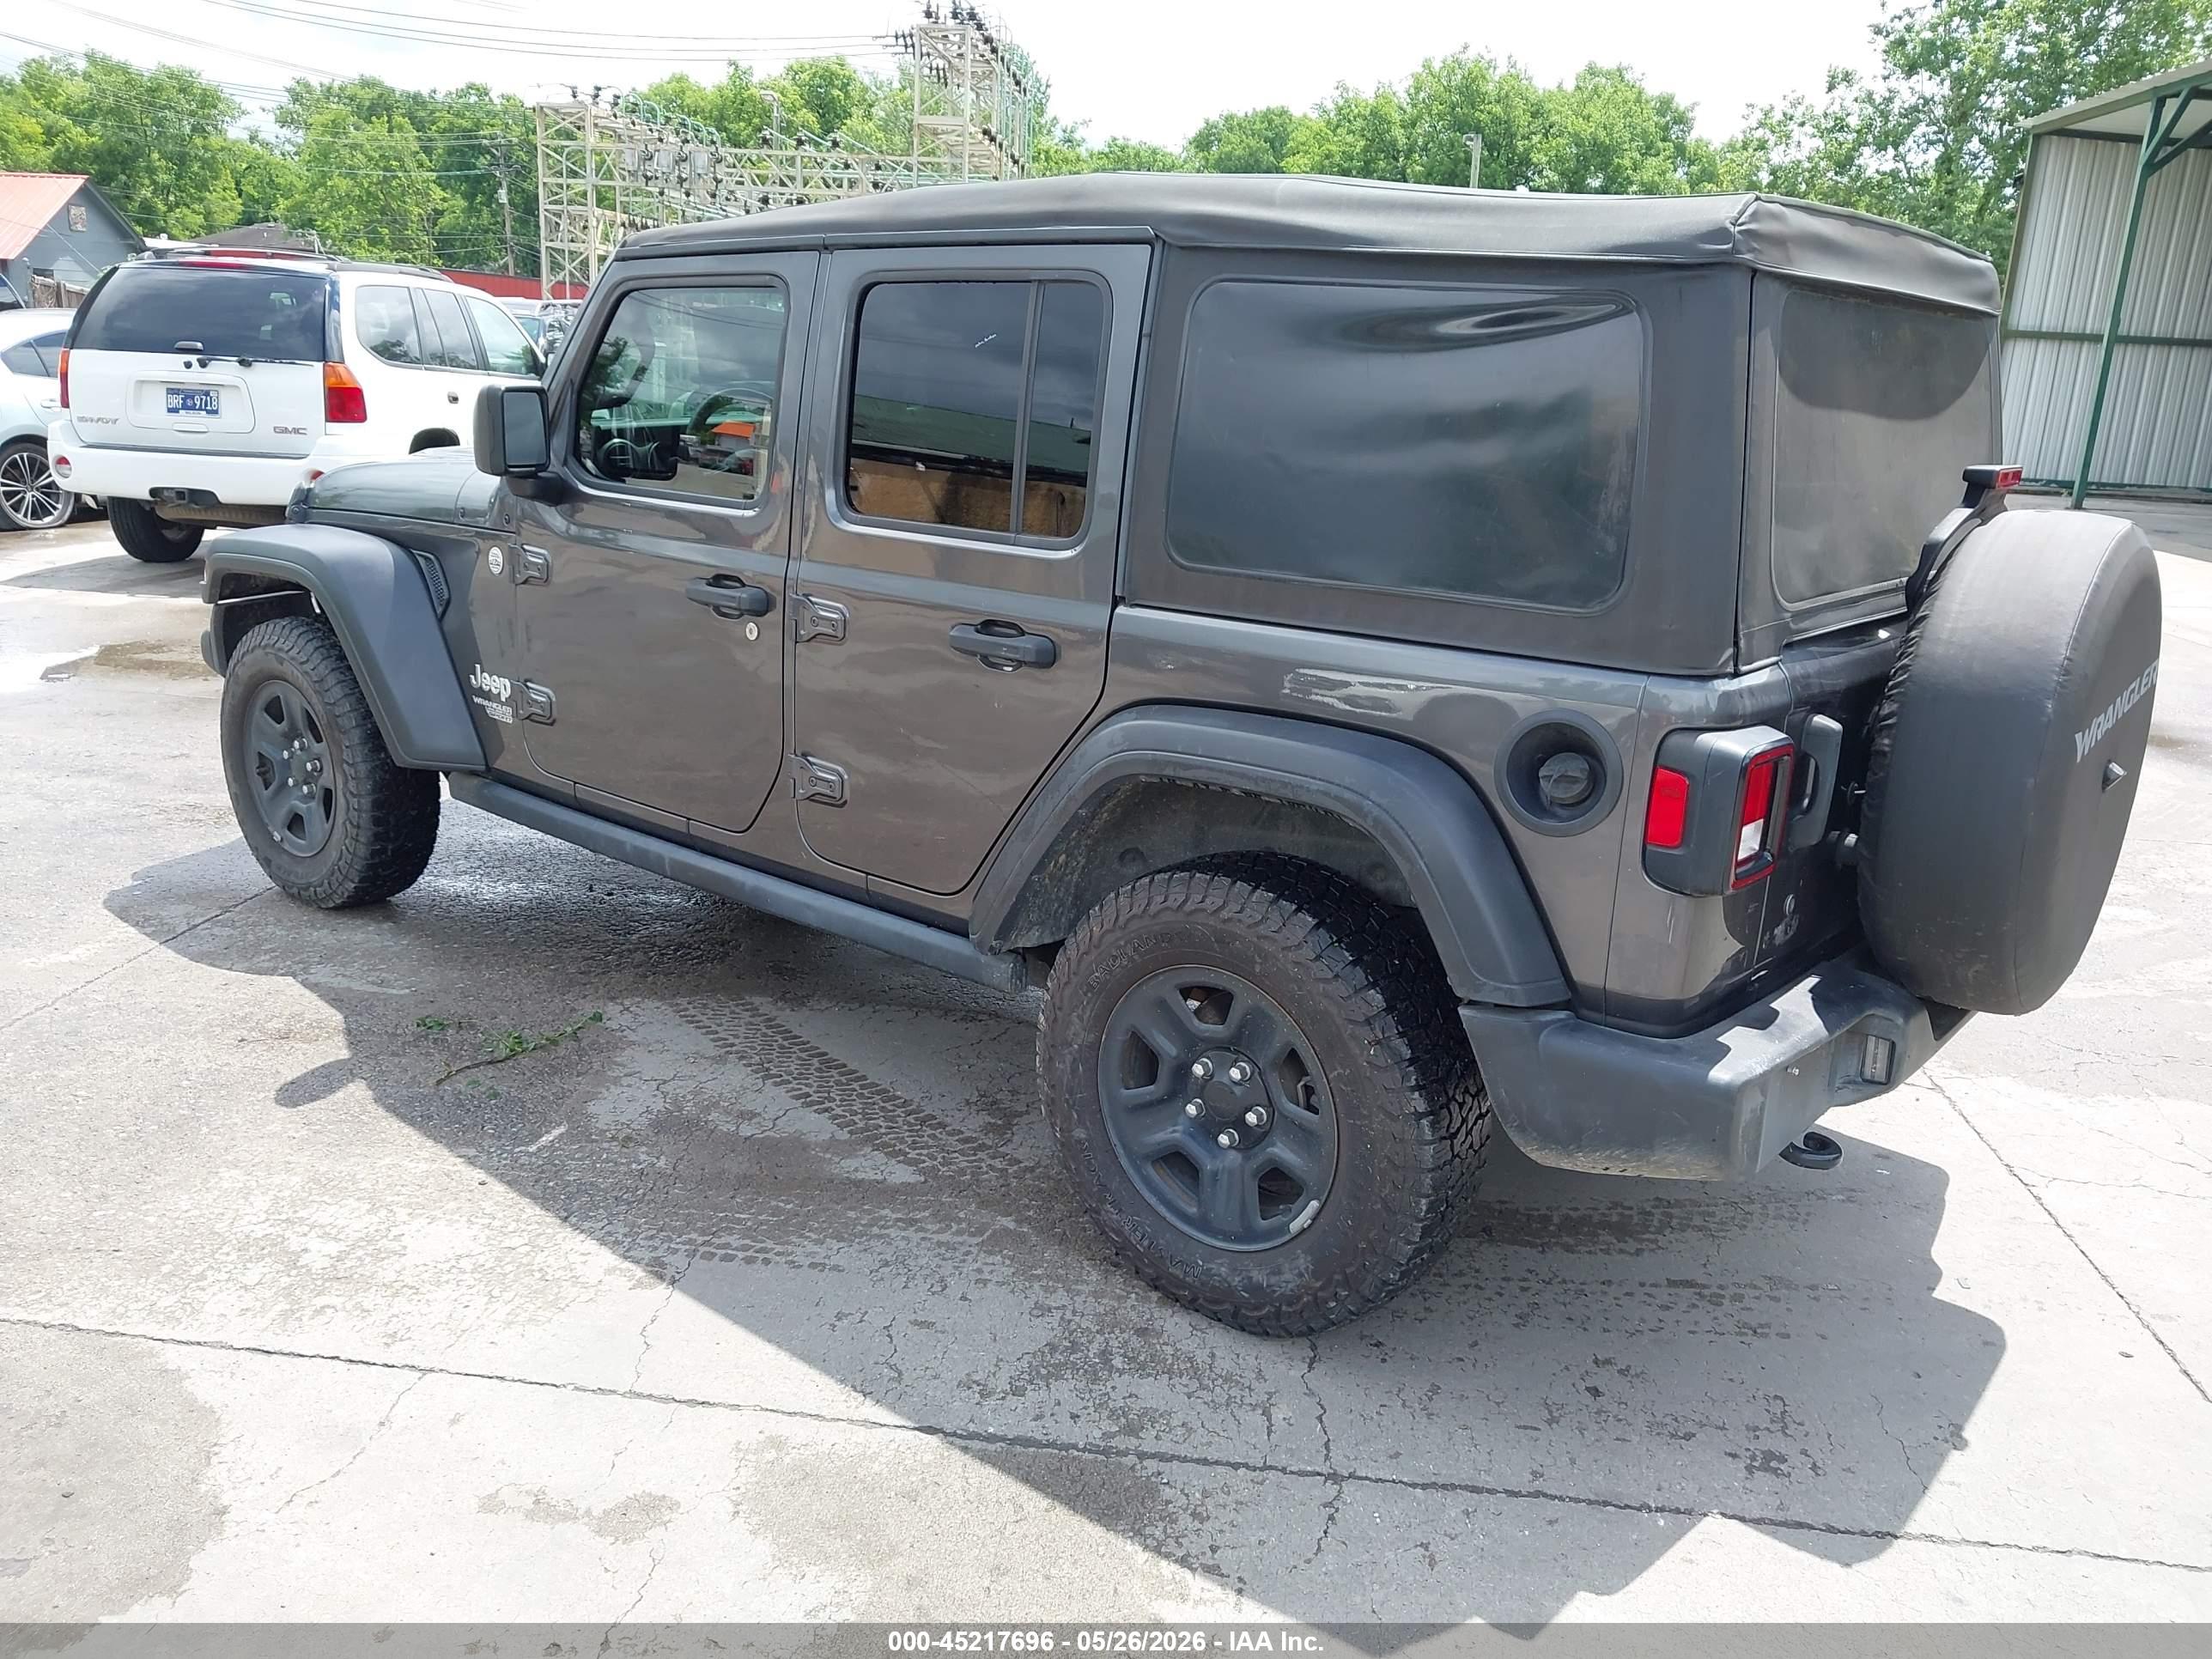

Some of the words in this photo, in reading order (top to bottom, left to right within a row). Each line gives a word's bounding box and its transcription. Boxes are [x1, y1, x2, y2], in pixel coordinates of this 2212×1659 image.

[167, 394, 185, 409] BRF
[194, 395, 218, 410] 9718
[273, 426, 307, 435] GMC
[469, 664, 511, 702] Jeep
[2075, 658, 2159, 763] WRANGLER
